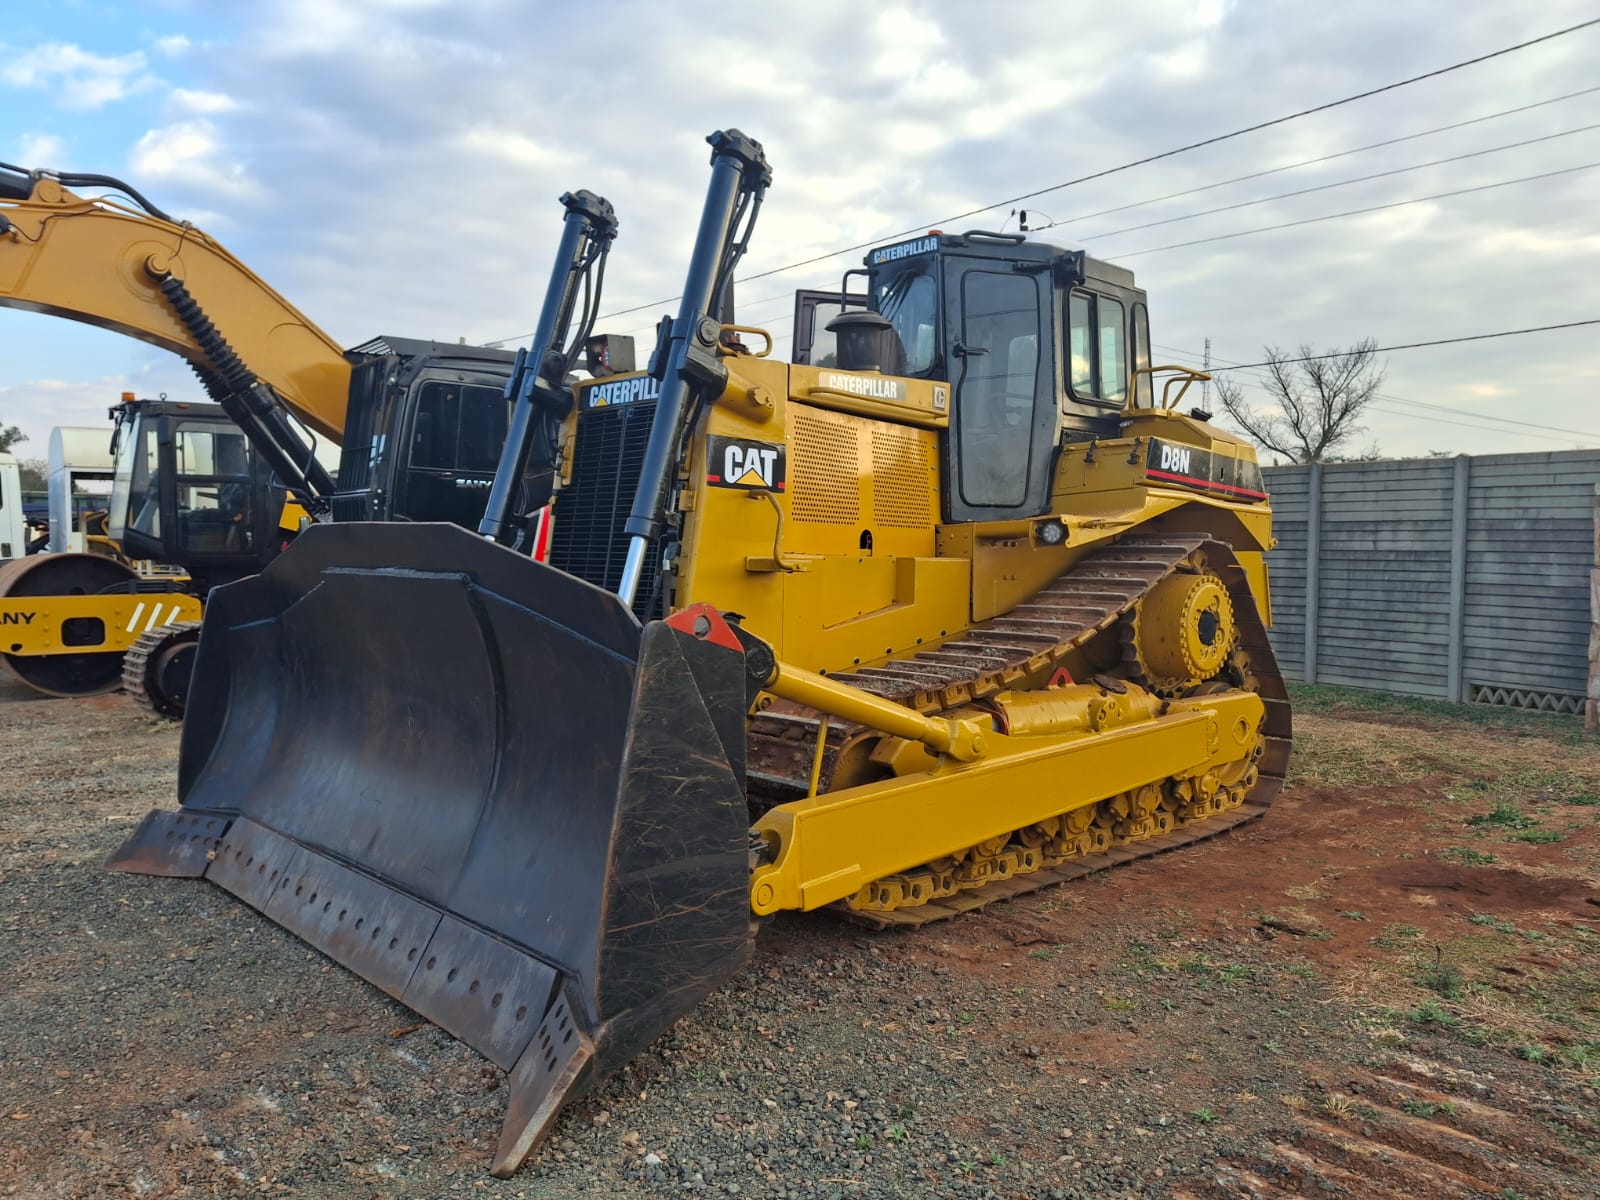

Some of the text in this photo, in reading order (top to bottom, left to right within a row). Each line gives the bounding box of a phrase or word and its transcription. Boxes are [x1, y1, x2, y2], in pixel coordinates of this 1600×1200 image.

[874, 237, 938, 264] CATERPILLAR
[589, 377, 660, 408] CATERPILL
[829, 375, 897, 399] CATERPILLAR
[724, 444, 778, 487] CAT
[1161, 445, 1190, 474] D8N
[0, 611, 37, 625] NY
